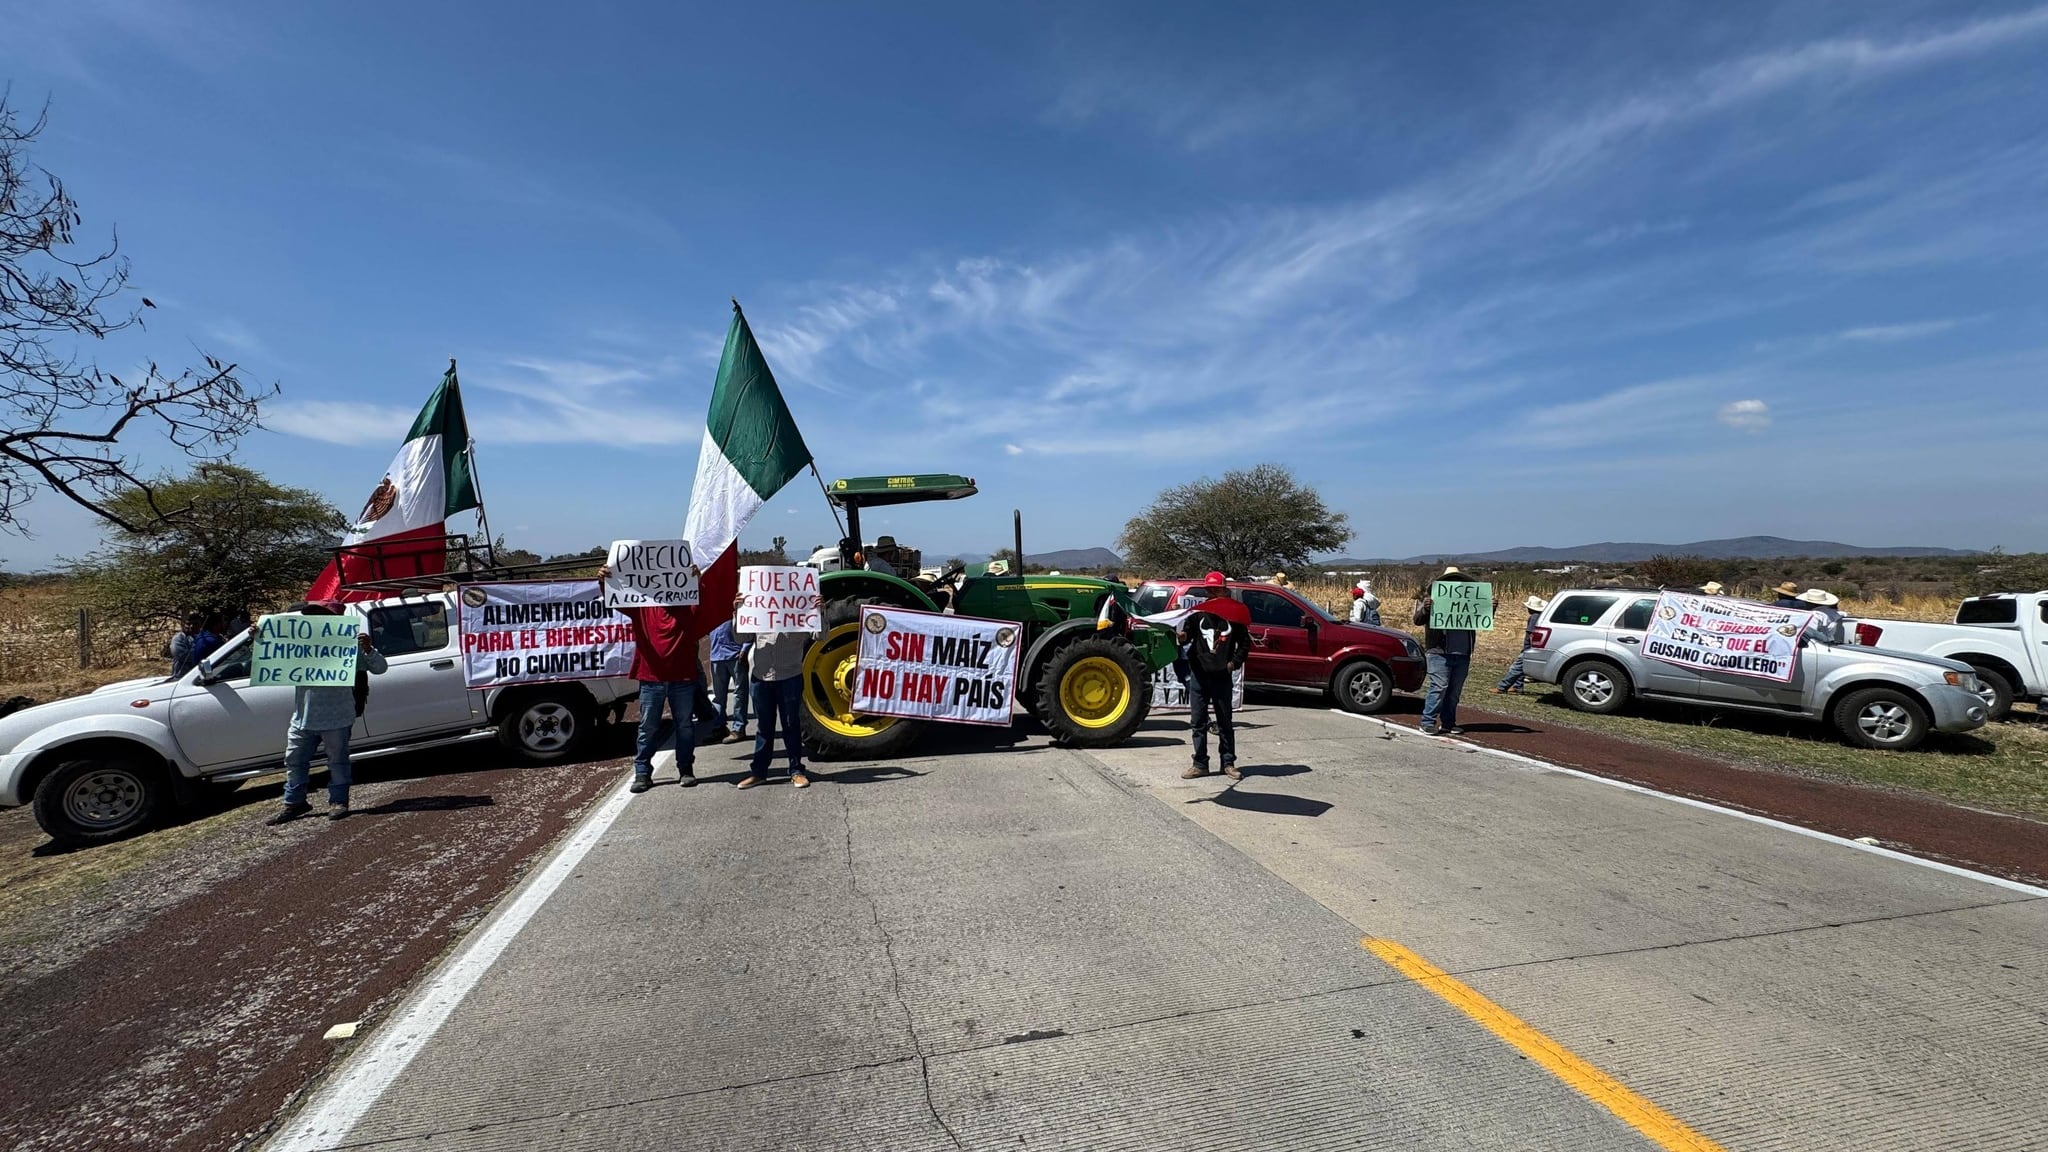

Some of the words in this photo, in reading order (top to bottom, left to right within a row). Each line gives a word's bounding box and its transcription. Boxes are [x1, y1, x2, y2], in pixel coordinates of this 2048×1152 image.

[616, 544, 691, 572] PRECIO
[623, 572, 688, 589] JUSTO
[749, 570, 816, 592] FUERA
[609, 593, 619, 606] A
[624, 594, 647, 603] LOS
[653, 590, 698, 603] GRANOS
[743, 594, 818, 610] GRANOS
[1438, 583, 1488, 600] DISEL
[483, 596, 614, 626] ALIMENTACIÓN
[740, 615, 760, 626] DEL
[767, 611, 818, 629] T-MEC
[1680, 613, 1702, 628] DEL
[260, 618, 312, 640] ALTO
[322, 622, 332, 637] A
[337, 623, 360, 639] LAS
[464, 632, 514, 653] PARA
[520, 629, 540, 650] EL
[546, 623, 636, 648] BIENESTAR
[886, 631, 926, 662] SIN
[931, 633, 992, 669] MAÍZ
[1649, 641, 1700, 662] GUSANO
[1726, 637, 1752, 651] QUE
[1753, 639, 1769, 653] EL
[259, 667, 282, 682] DE
[288, 667, 348, 682] GRANO
[495, 657, 520, 678] NO
[527, 651, 605, 675] CUMPLE!
[862, 668, 895, 700] NO
[901, 672, 949, 704] HAY
[953, 674, 1005, 710] PAÍS
